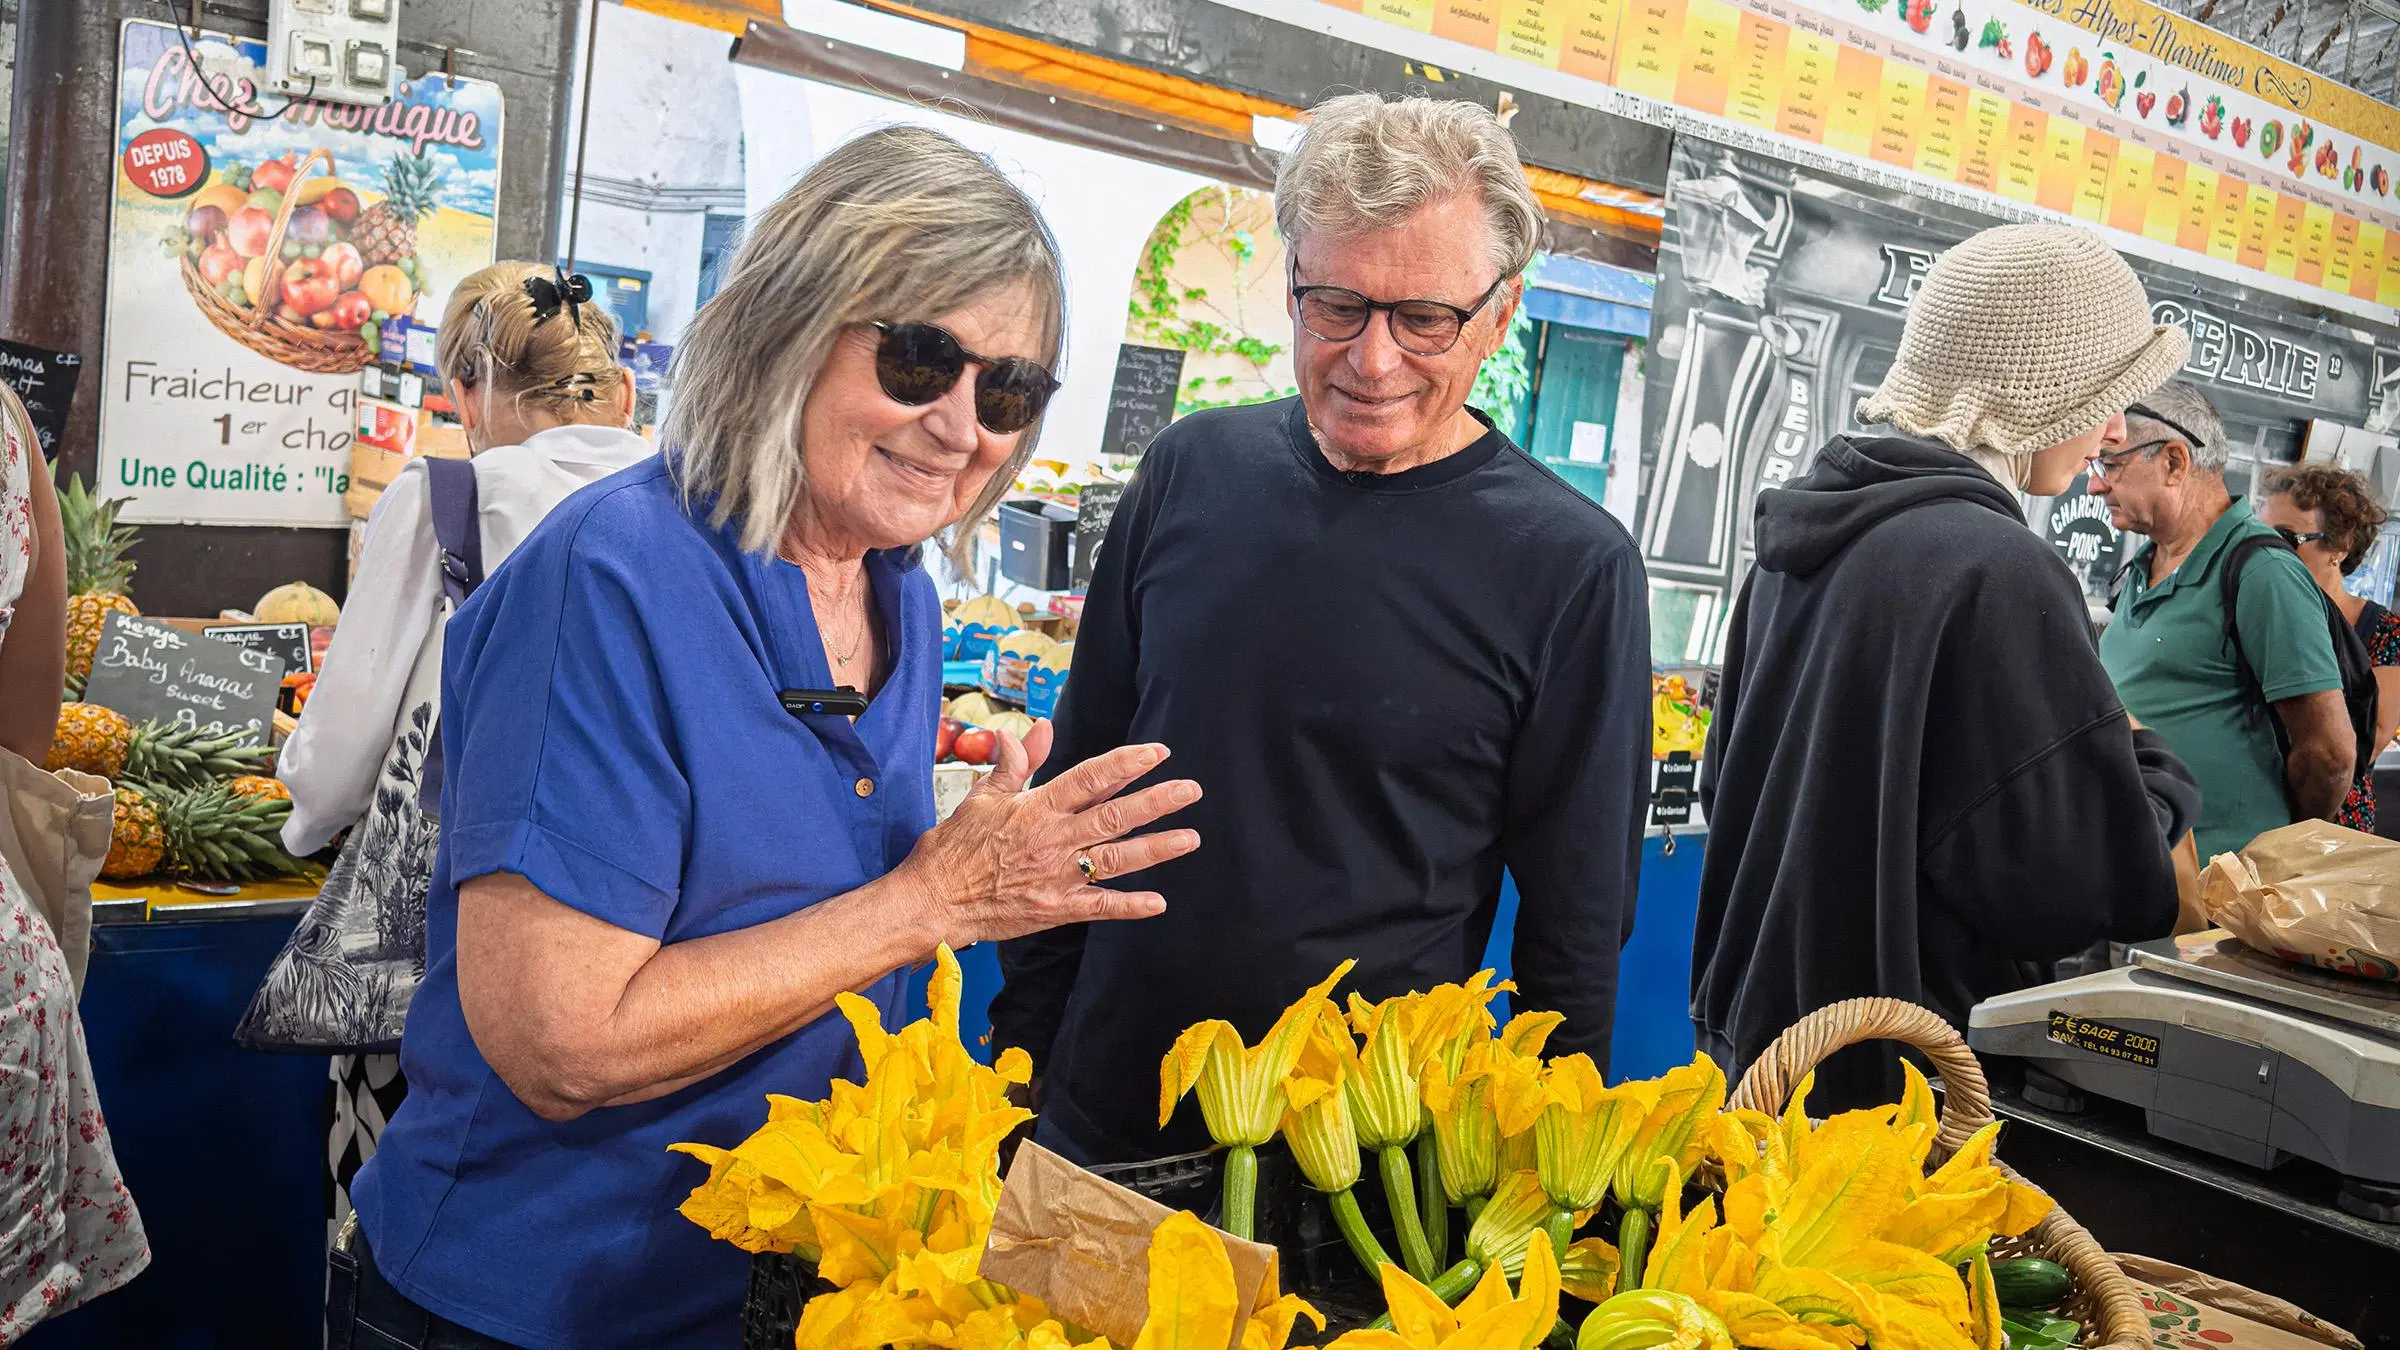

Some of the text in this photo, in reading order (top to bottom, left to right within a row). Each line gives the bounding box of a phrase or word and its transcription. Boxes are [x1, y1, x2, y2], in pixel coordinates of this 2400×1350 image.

[2070, 0, 2244, 87] Alpes-Maritimes
[143, 45, 261, 131] Chez
[130, 138, 192, 168] DEPUIS
[149, 164, 187, 189] 1978
[125, 360, 357, 414] Fraicheur q
[282, 416, 356, 451] cho
[1759, 378, 1810, 490] BEUR
[120, 458, 177, 488] Une
[186, 460, 288, 492] Qualité
[2067, 531, 2102, 561] PONS
[115, 614, 188, 650] Kenya
[101, 636, 168, 684] Baby
[165, 684, 227, 712] Sweet
[2099, 1045, 2109, 1054] 04
[2110, 1048, 2120, 1057] 93
[2121, 1051, 2132, 1060] 07
[2133, 1054, 2143, 1063] 28
[2145, 1057, 2154, 1065] 31
[2124, 1033, 2157, 1053] 2000
